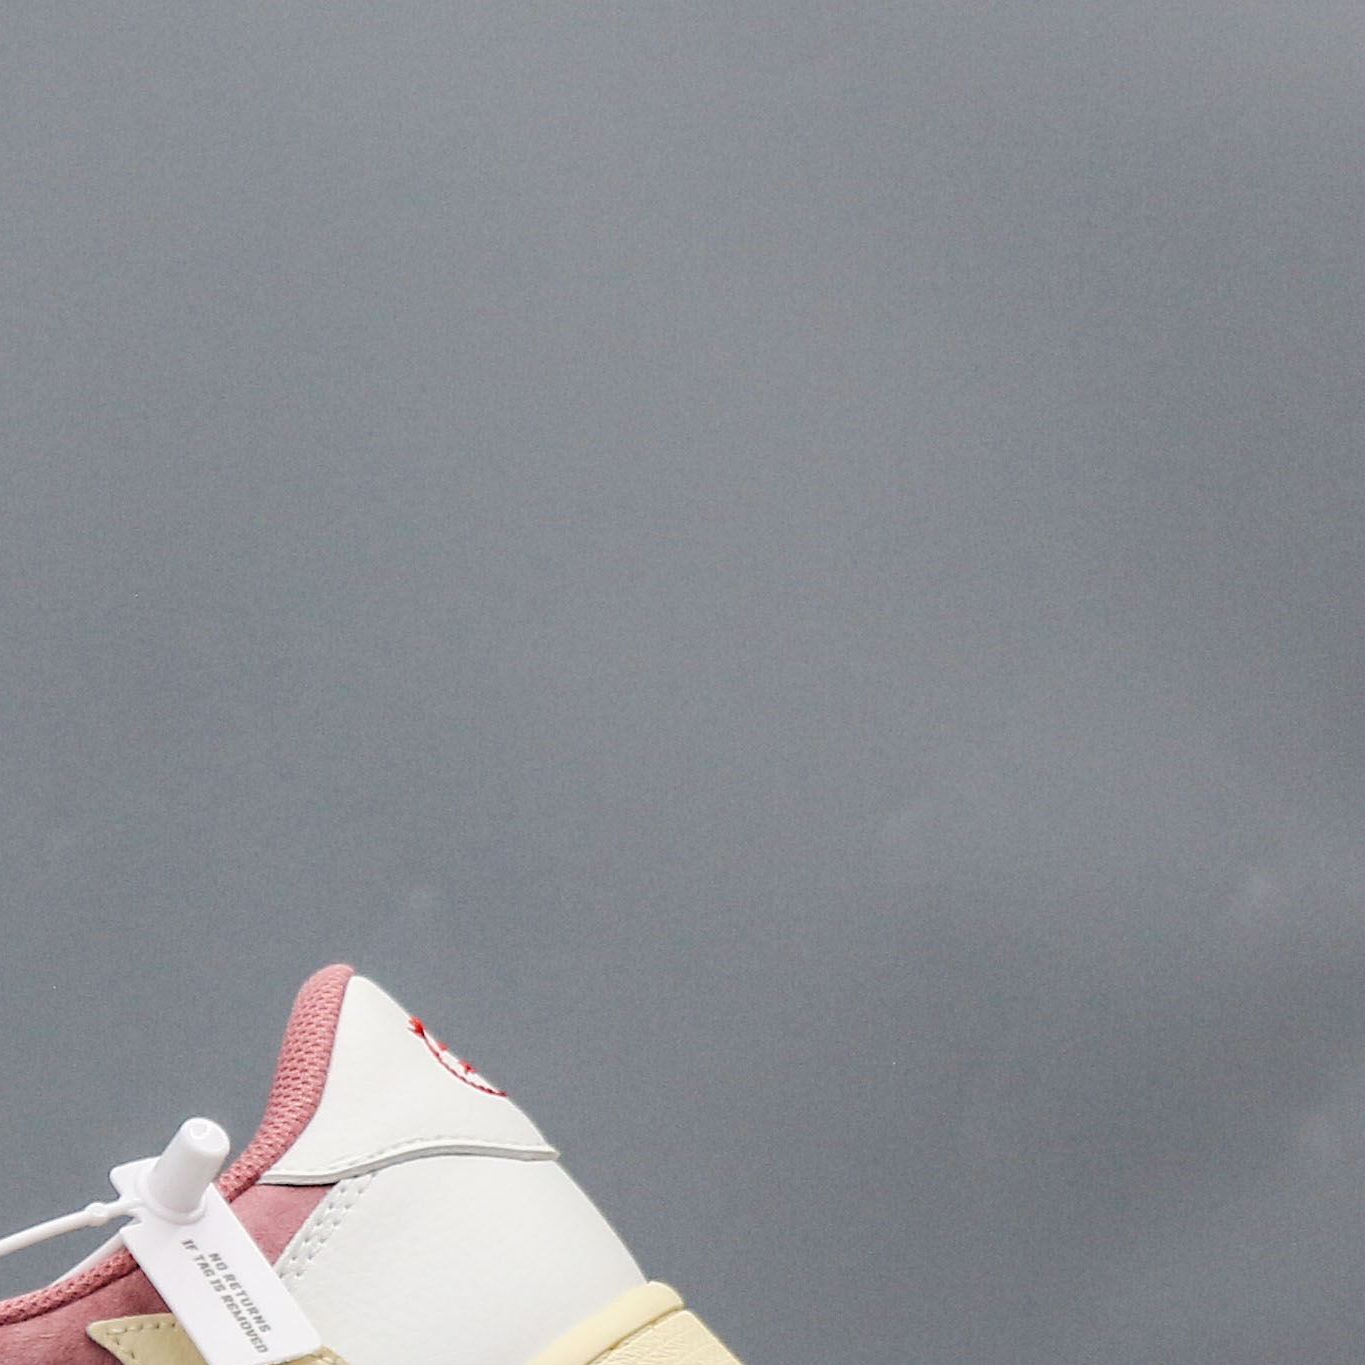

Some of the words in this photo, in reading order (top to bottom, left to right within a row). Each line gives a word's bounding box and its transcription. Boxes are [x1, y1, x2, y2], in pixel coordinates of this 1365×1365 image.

[181, 1239, 198, 1251] IF
[193, 1254, 215, 1277] TAG
[210, 1279, 226, 1292] IS
[220, 1294, 269, 1353] REMOVED
[208, 1252, 228, 1271] NO
[222, 1273, 271, 1333] RETURNS
